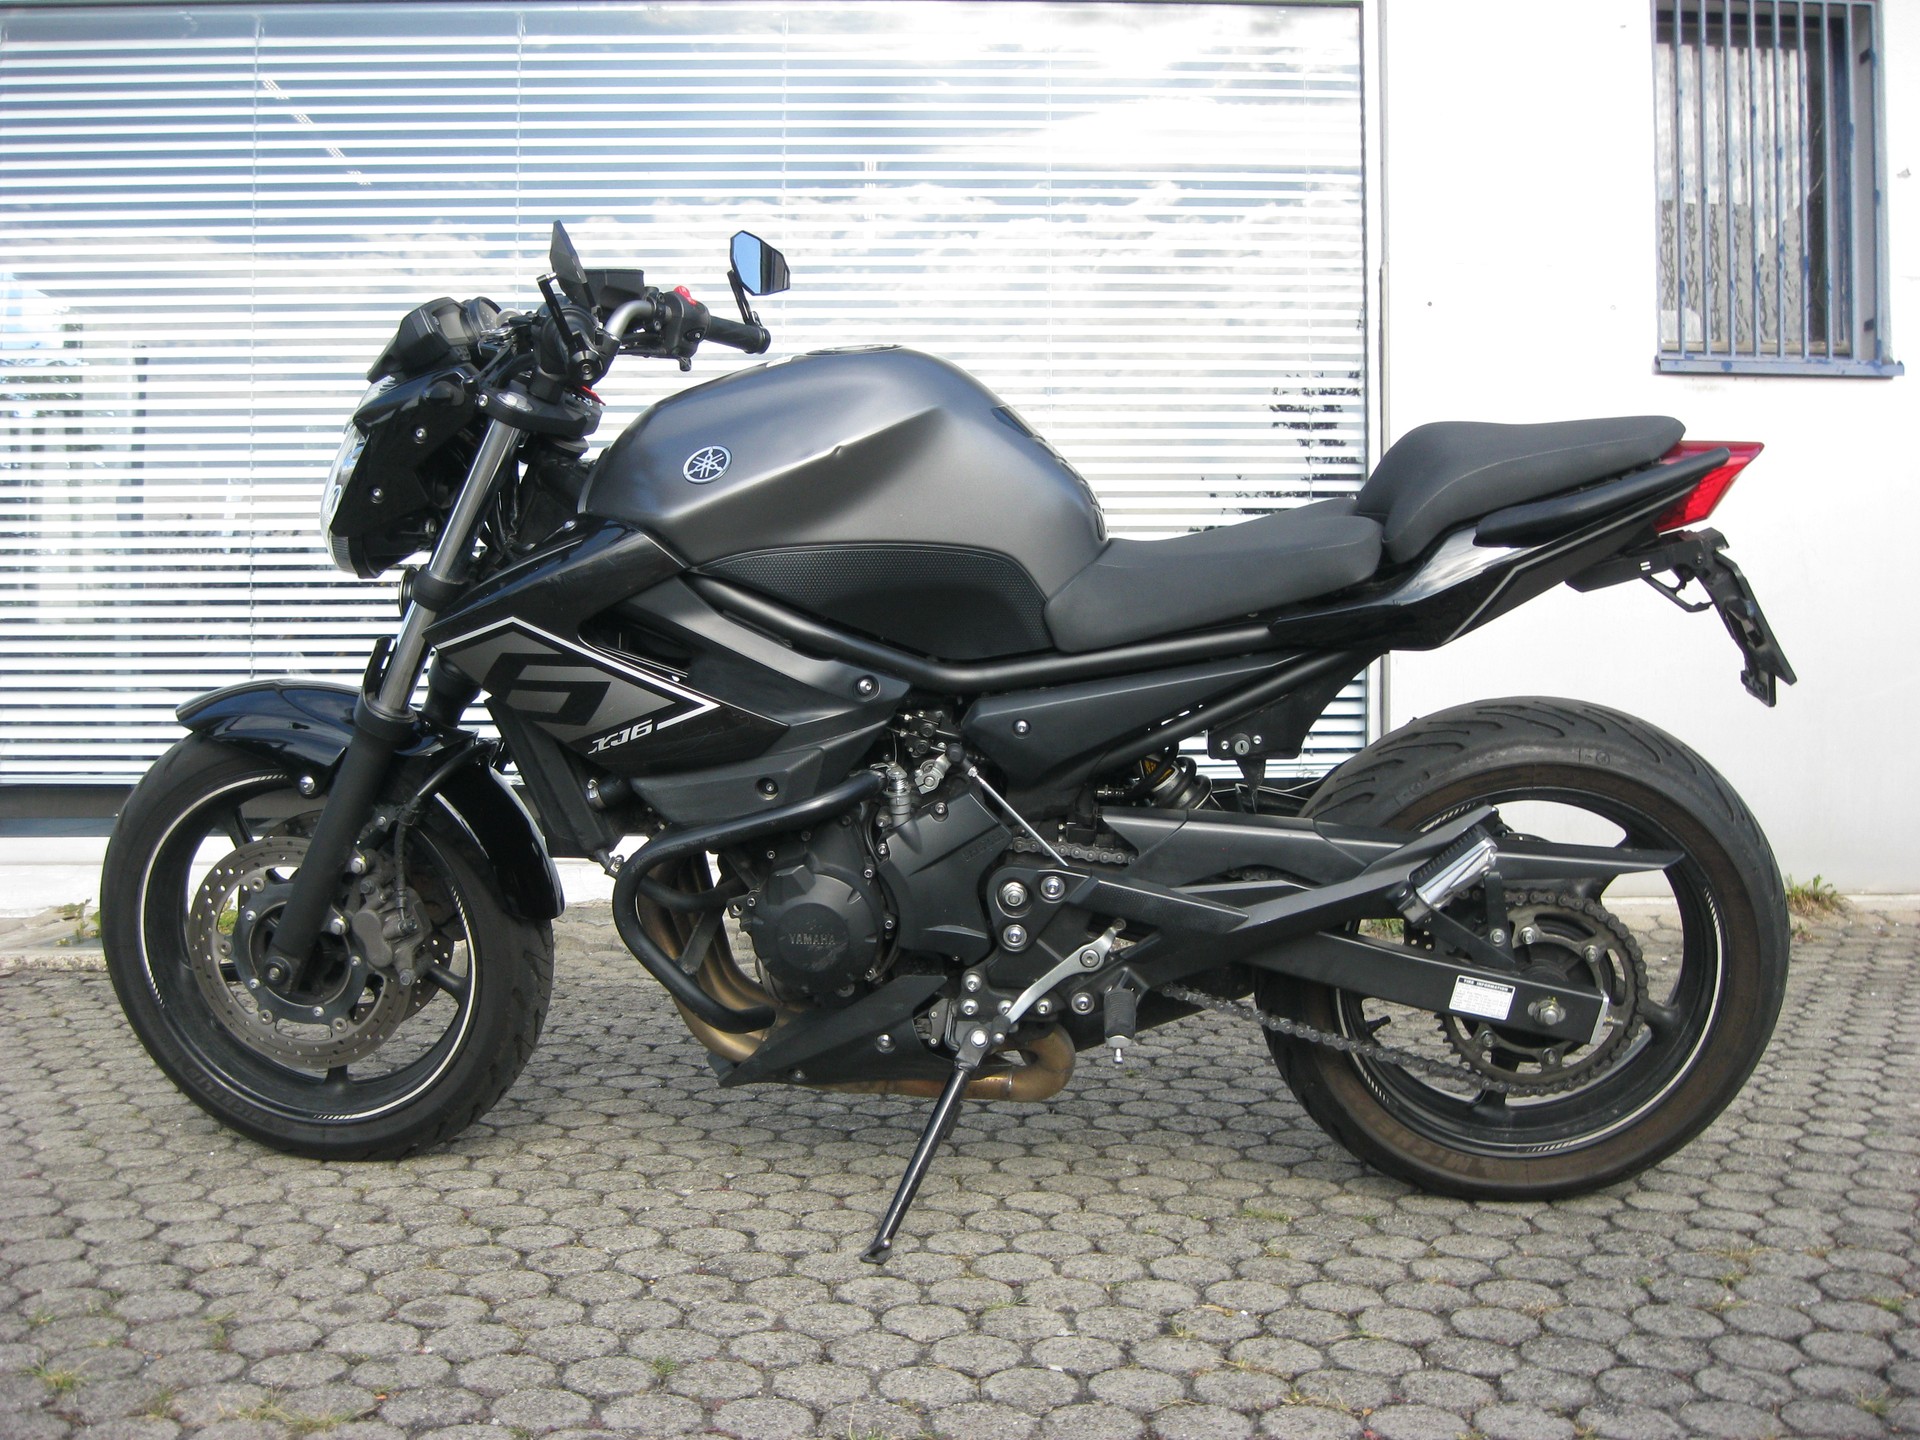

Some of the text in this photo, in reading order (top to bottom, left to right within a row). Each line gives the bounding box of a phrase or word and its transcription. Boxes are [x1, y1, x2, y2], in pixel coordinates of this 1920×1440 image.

[587, 718, 653, 755] XJ6
[788, 933, 836, 945] YAMAHA
[1476, 981, 1509, 992] INFORMATION
